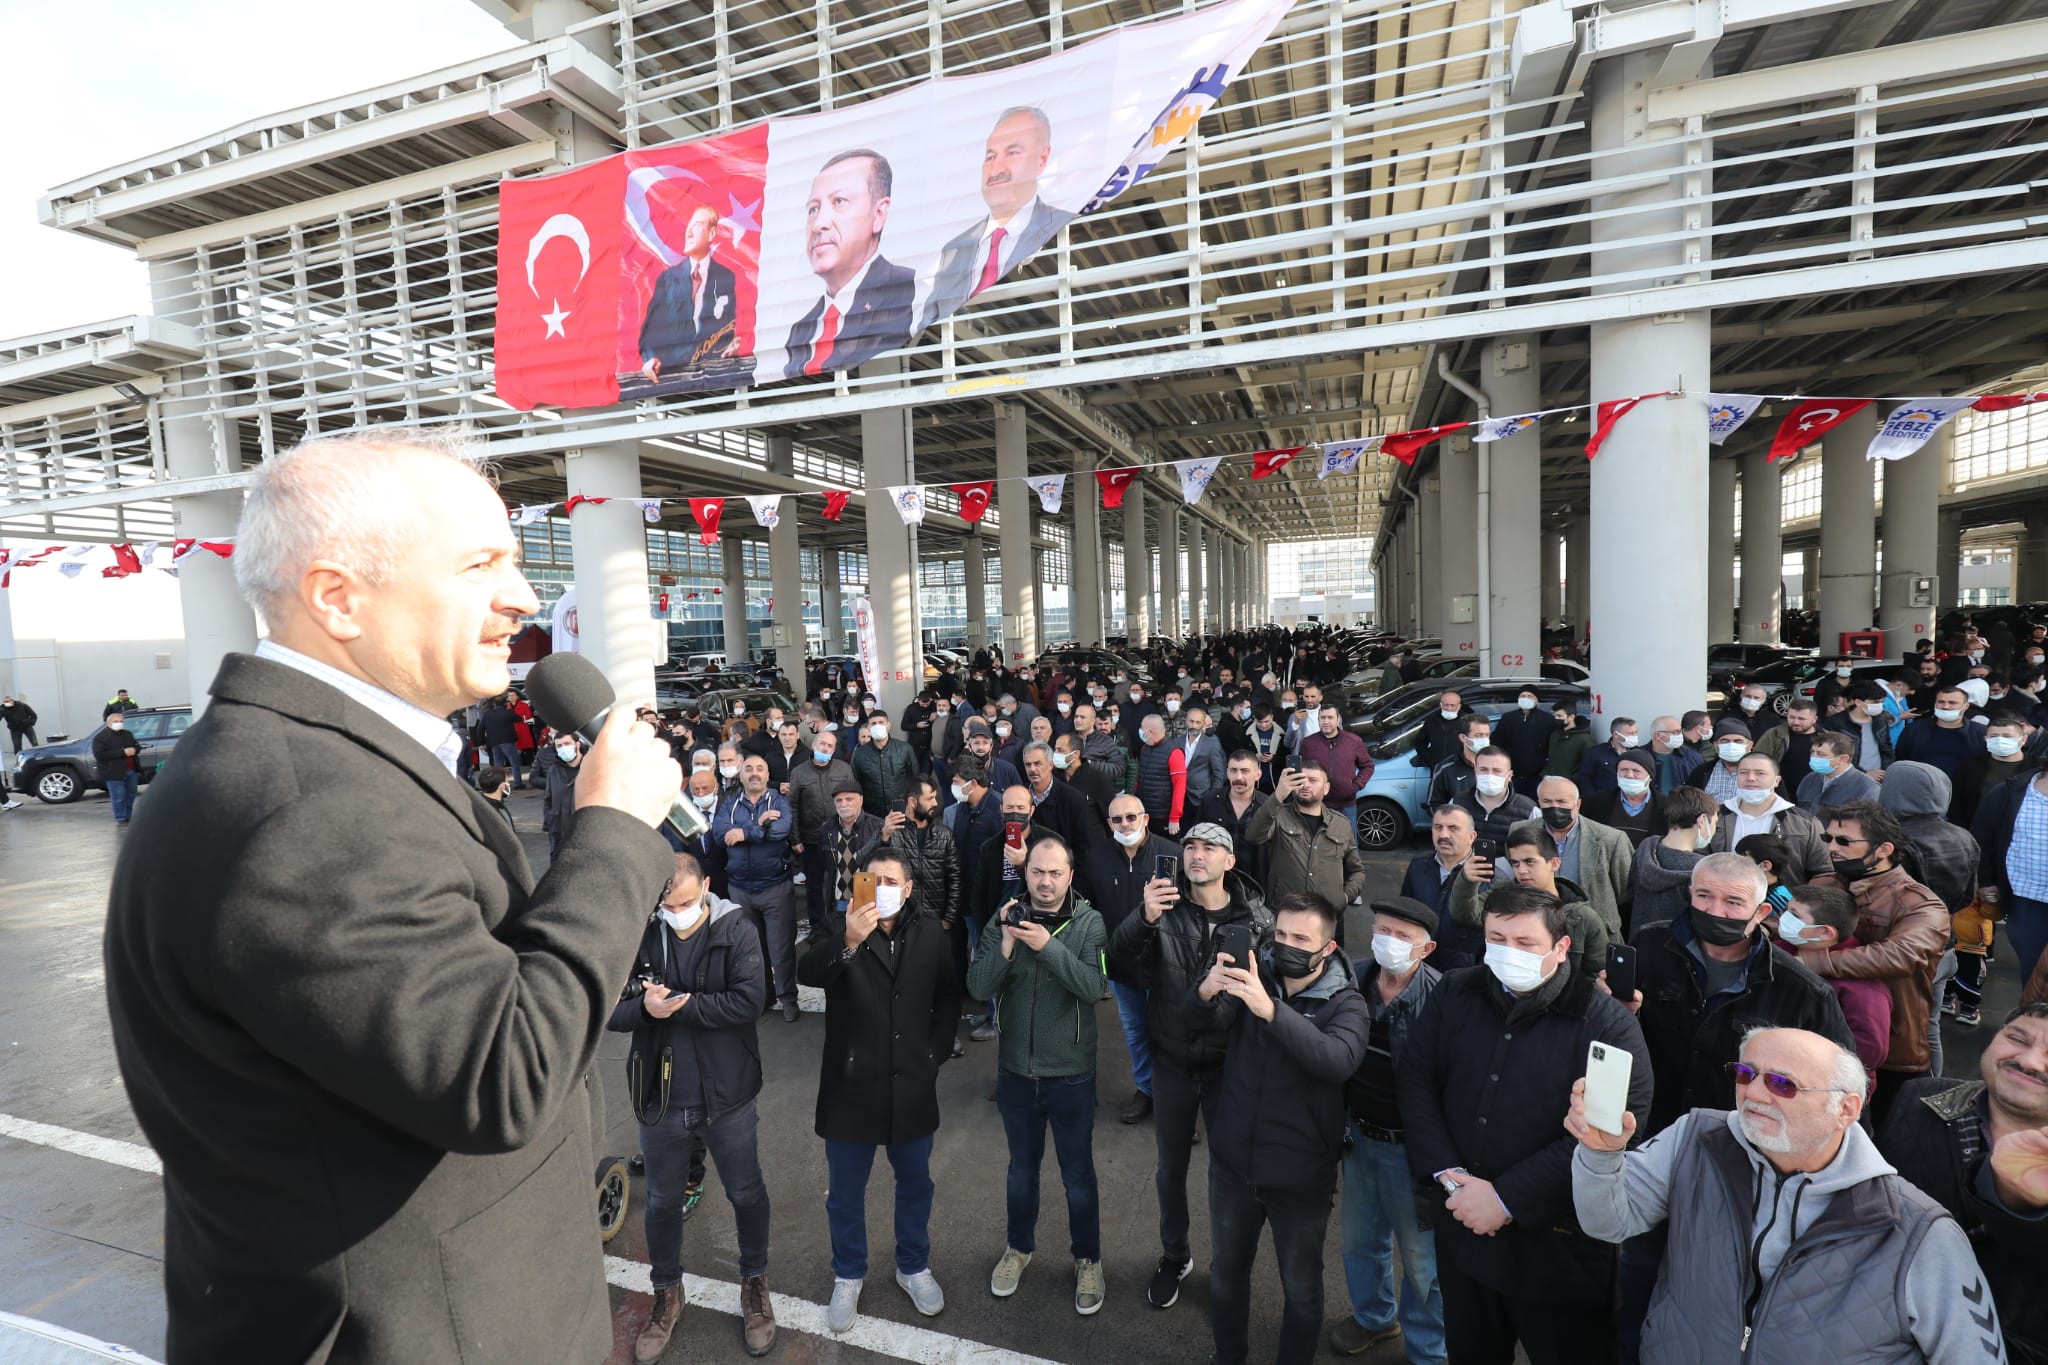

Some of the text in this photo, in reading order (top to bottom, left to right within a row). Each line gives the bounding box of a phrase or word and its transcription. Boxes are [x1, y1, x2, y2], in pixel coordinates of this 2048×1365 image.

[1914, 624, 1924, 633] D
[1459, 641, 1474, 651] C4
[1501, 654, 1525, 667] C2
[895, 671, 911, 681] B2
